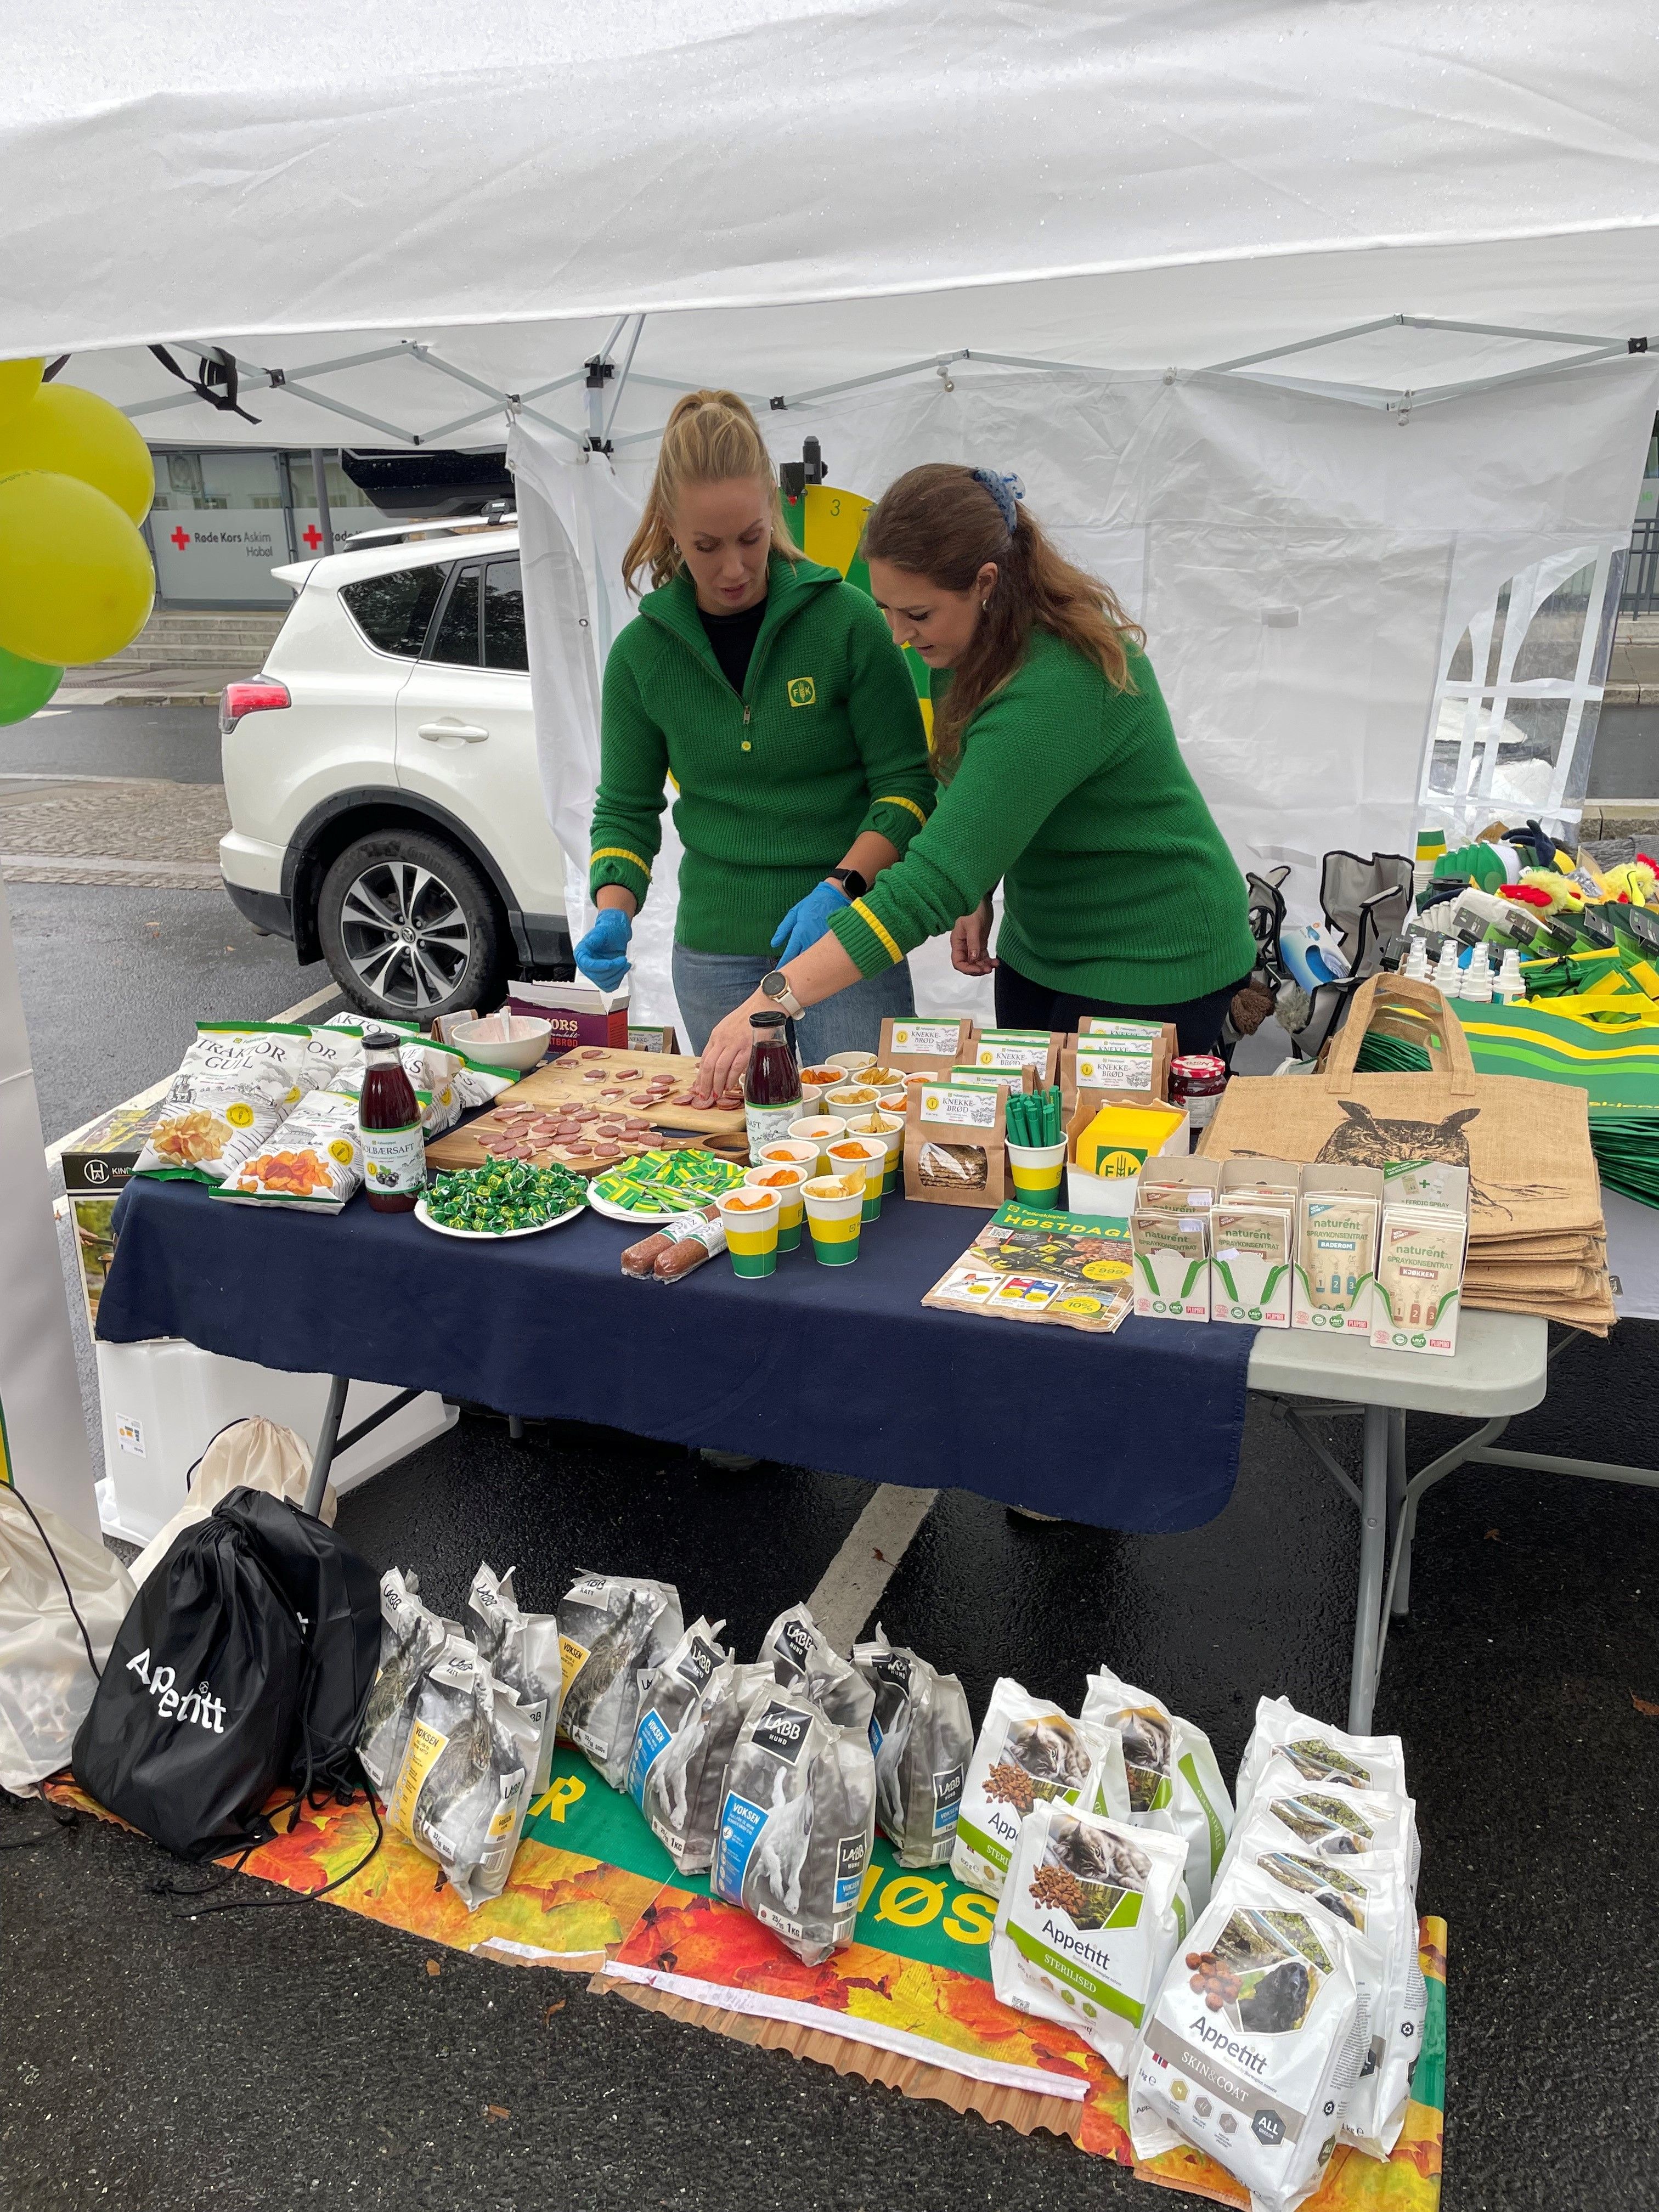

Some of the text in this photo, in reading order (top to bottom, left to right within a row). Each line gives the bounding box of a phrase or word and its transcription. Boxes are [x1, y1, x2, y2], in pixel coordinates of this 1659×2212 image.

[830, 499, 840, 517] 3
[195, 532, 272, 543] Røde Kors Askim
[546, 1018, 578, 1031] ORS
[551, 1037, 578, 1047] TBRØD
[196, 1038, 286, 1063] TRAKTOR
[205, 1057, 254, 1070] GULL
[947, 1105, 969, 1114] BRØD
[1306, 1230, 1369, 1240] SPRAYKONSENTRAT
[1139, 1239, 1197, 1250] SPRAYKONSENTRAT
[1218, 1239, 1279, 1250] SPRAYKONSENTRAT
[1387, 1255, 1454, 1270] SPRAYKONSENTRAT
[1403, 1268, 1435, 1278] KJØKKEN
[1349, 1282, 1355, 1290] 3
[1068, 1301, 1093, 1311] 10%
[1412, 1310, 1419, 1318] 2
[1429, 1312, 1435, 1320] 3
[580, 1587, 594, 1596] KATT
[563, 1642, 583, 1660] VOKSEN
[789, 1641, 803, 1656] HUND
[647, 1718, 665, 1743] VOKSEN
[764, 1713, 801, 1740] LABB
[415, 1726, 439, 1747] VOKSEN
[769, 1734, 787, 1746] HUND
[939, 1776, 960, 1797] LABB
[733, 1803, 760, 1825] VOKSEN
[842, 1844, 865, 1863] LABB
[1041, 1919, 1110, 1971] Appetitt
[1044, 1954, 1097, 1993] STERILISED
[1189, 2016, 1268, 2075] Appetitt
[1181, 2052, 1249, 2103] SKIN&COAT
[1244, 2070, 1263, 2087] Norwegian
[1257, 2116, 1279, 2135] ALL
